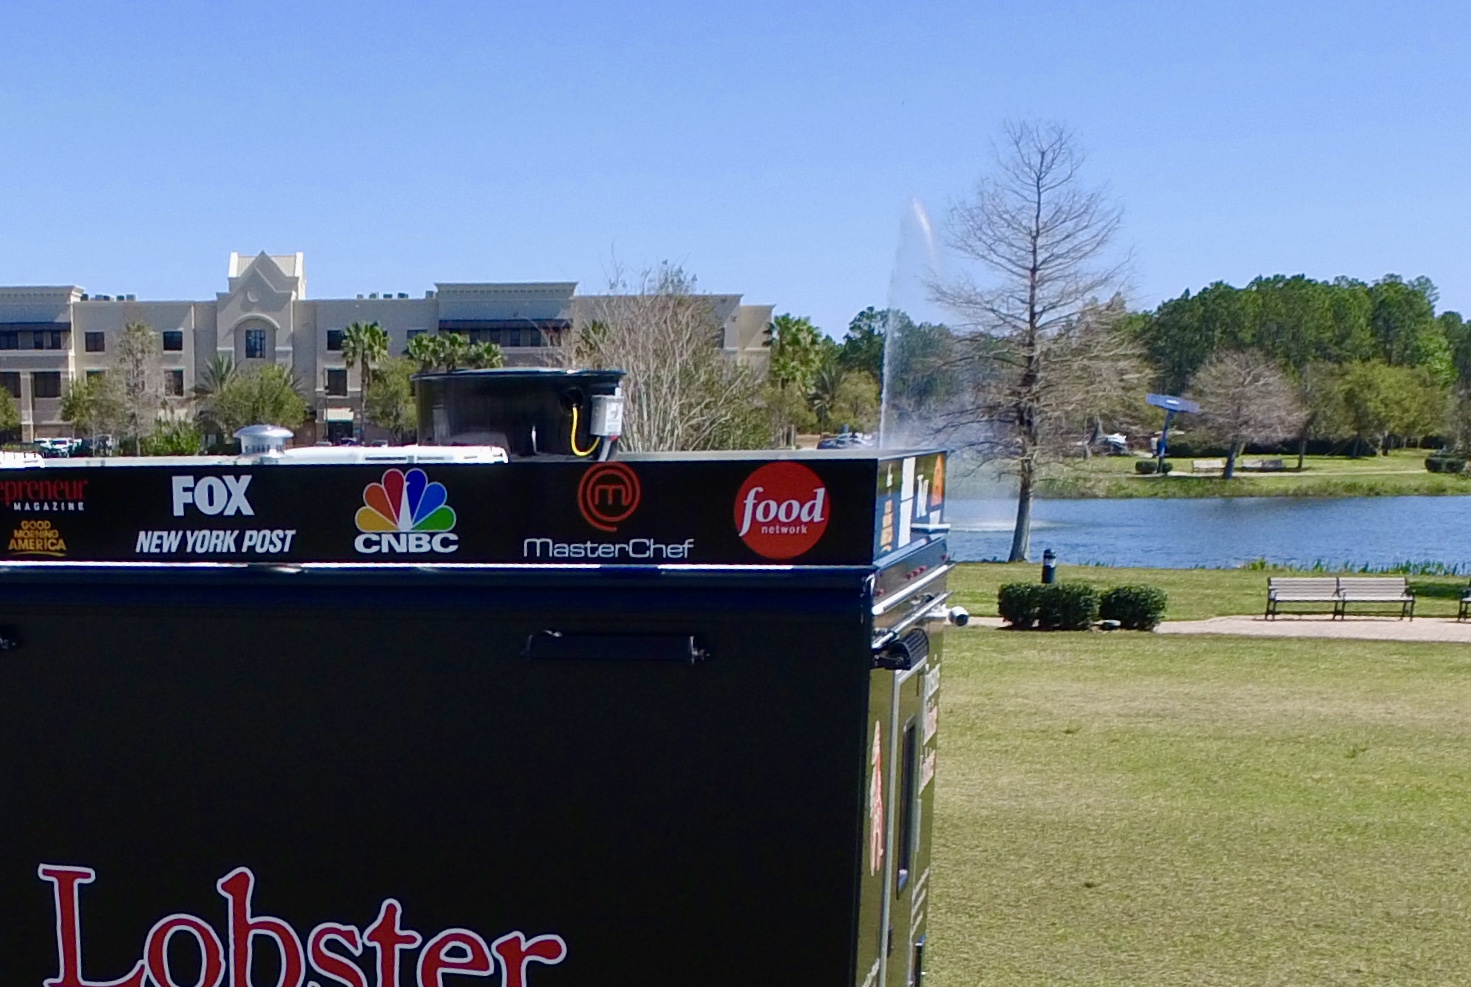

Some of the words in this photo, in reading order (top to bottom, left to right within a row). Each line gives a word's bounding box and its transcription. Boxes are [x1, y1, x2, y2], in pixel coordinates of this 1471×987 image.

[171, 475, 255, 517] FOX
[13, 502, 85, 511] MAGAZINE
[739, 487, 827, 537] food
[21, 520, 51, 531] GOOD
[761, 525, 808, 534] network
[13, 529, 60, 539] MORNING
[136, 530, 184, 553] NEW
[185, 530, 236, 553] YORK
[242, 530, 296, 553] POST
[8, 539, 67, 551] AMERICA
[354, 533, 459, 554] CNBC
[523, 538, 694, 559] MasterChef
